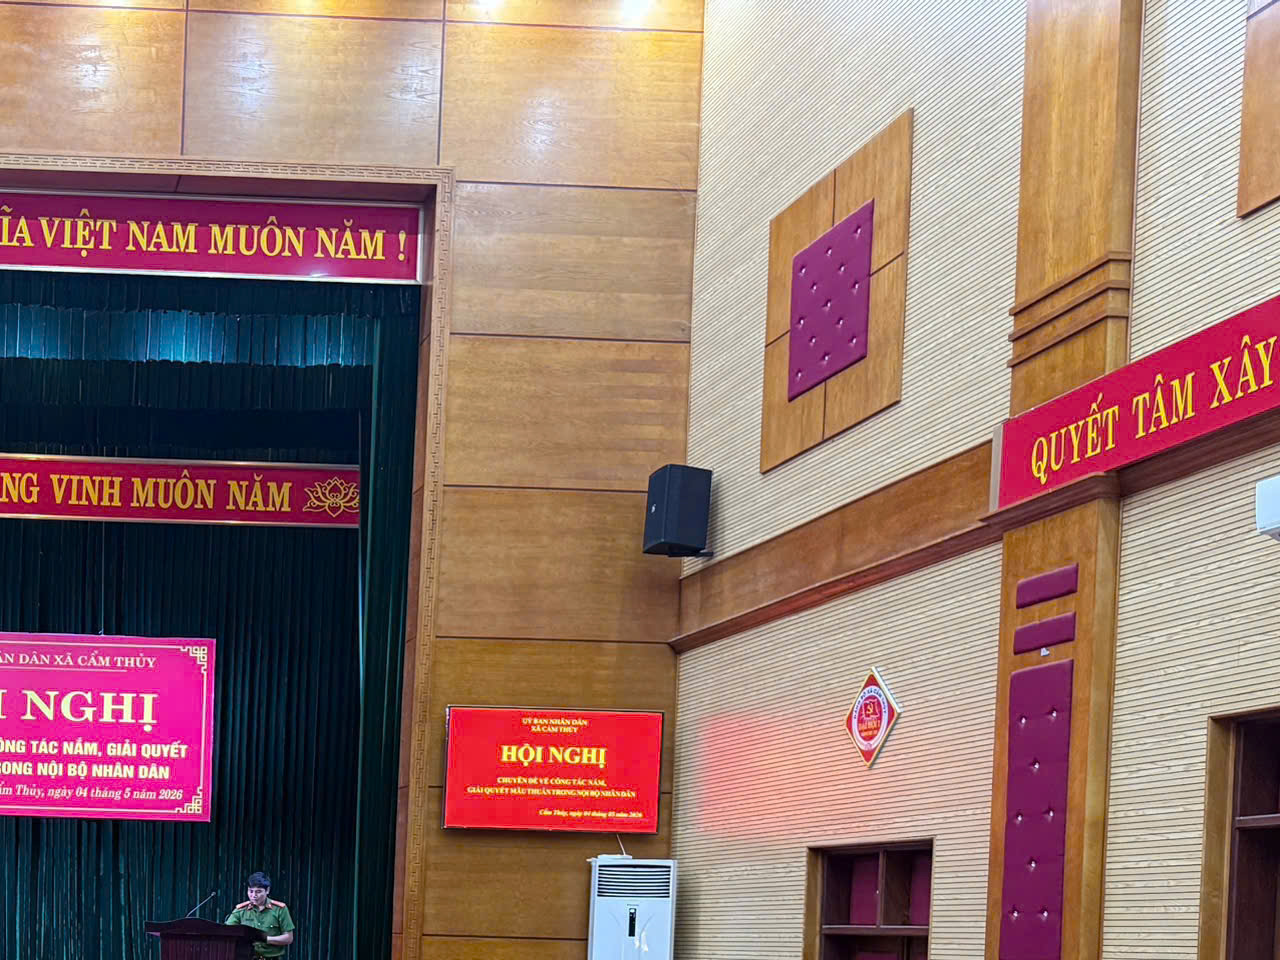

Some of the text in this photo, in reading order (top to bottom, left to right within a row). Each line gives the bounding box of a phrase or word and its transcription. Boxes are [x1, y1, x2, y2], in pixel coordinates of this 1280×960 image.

[38, 209, 117, 258] VIỆT
[125, 221, 198, 254] NAM
[208, 216, 305, 257] MUÔN
[314, 219, 386, 260] NĂM
[1031, 334, 1278, 485] QUYẾT TÂM XÂY
[50, 474, 122, 508] VINH
[130, 469, 216, 510] MUÔN
[226, 472, 292, 512] NĂM
[19, 651, 50, 665] DÂN
[54, 652, 73, 666] XÃ
[78, 650, 110, 667] CẨM
[114, 653, 157, 668] THỦY
[21, 688, 159, 733] NGHỊ
[30, 738, 59, 754] TÁC
[106, 739, 137, 757] GIẢI
[141, 740, 188, 758] QUYẾT
[501, 743, 608, 769] HỘI NGHỊ
[37, 760, 63, 779] NỘI
[67, 761, 88, 780] BỘ
[92, 762, 135, 778] NHÂN
[138, 763, 170, 779] DÂN
[47, 785, 74, 799] ngày
[76, 786, 88, 798] 04
[90, 787, 122, 800] tháng
[124, 788, 131, 799] 5
[158, 789, 184, 800] 2026
